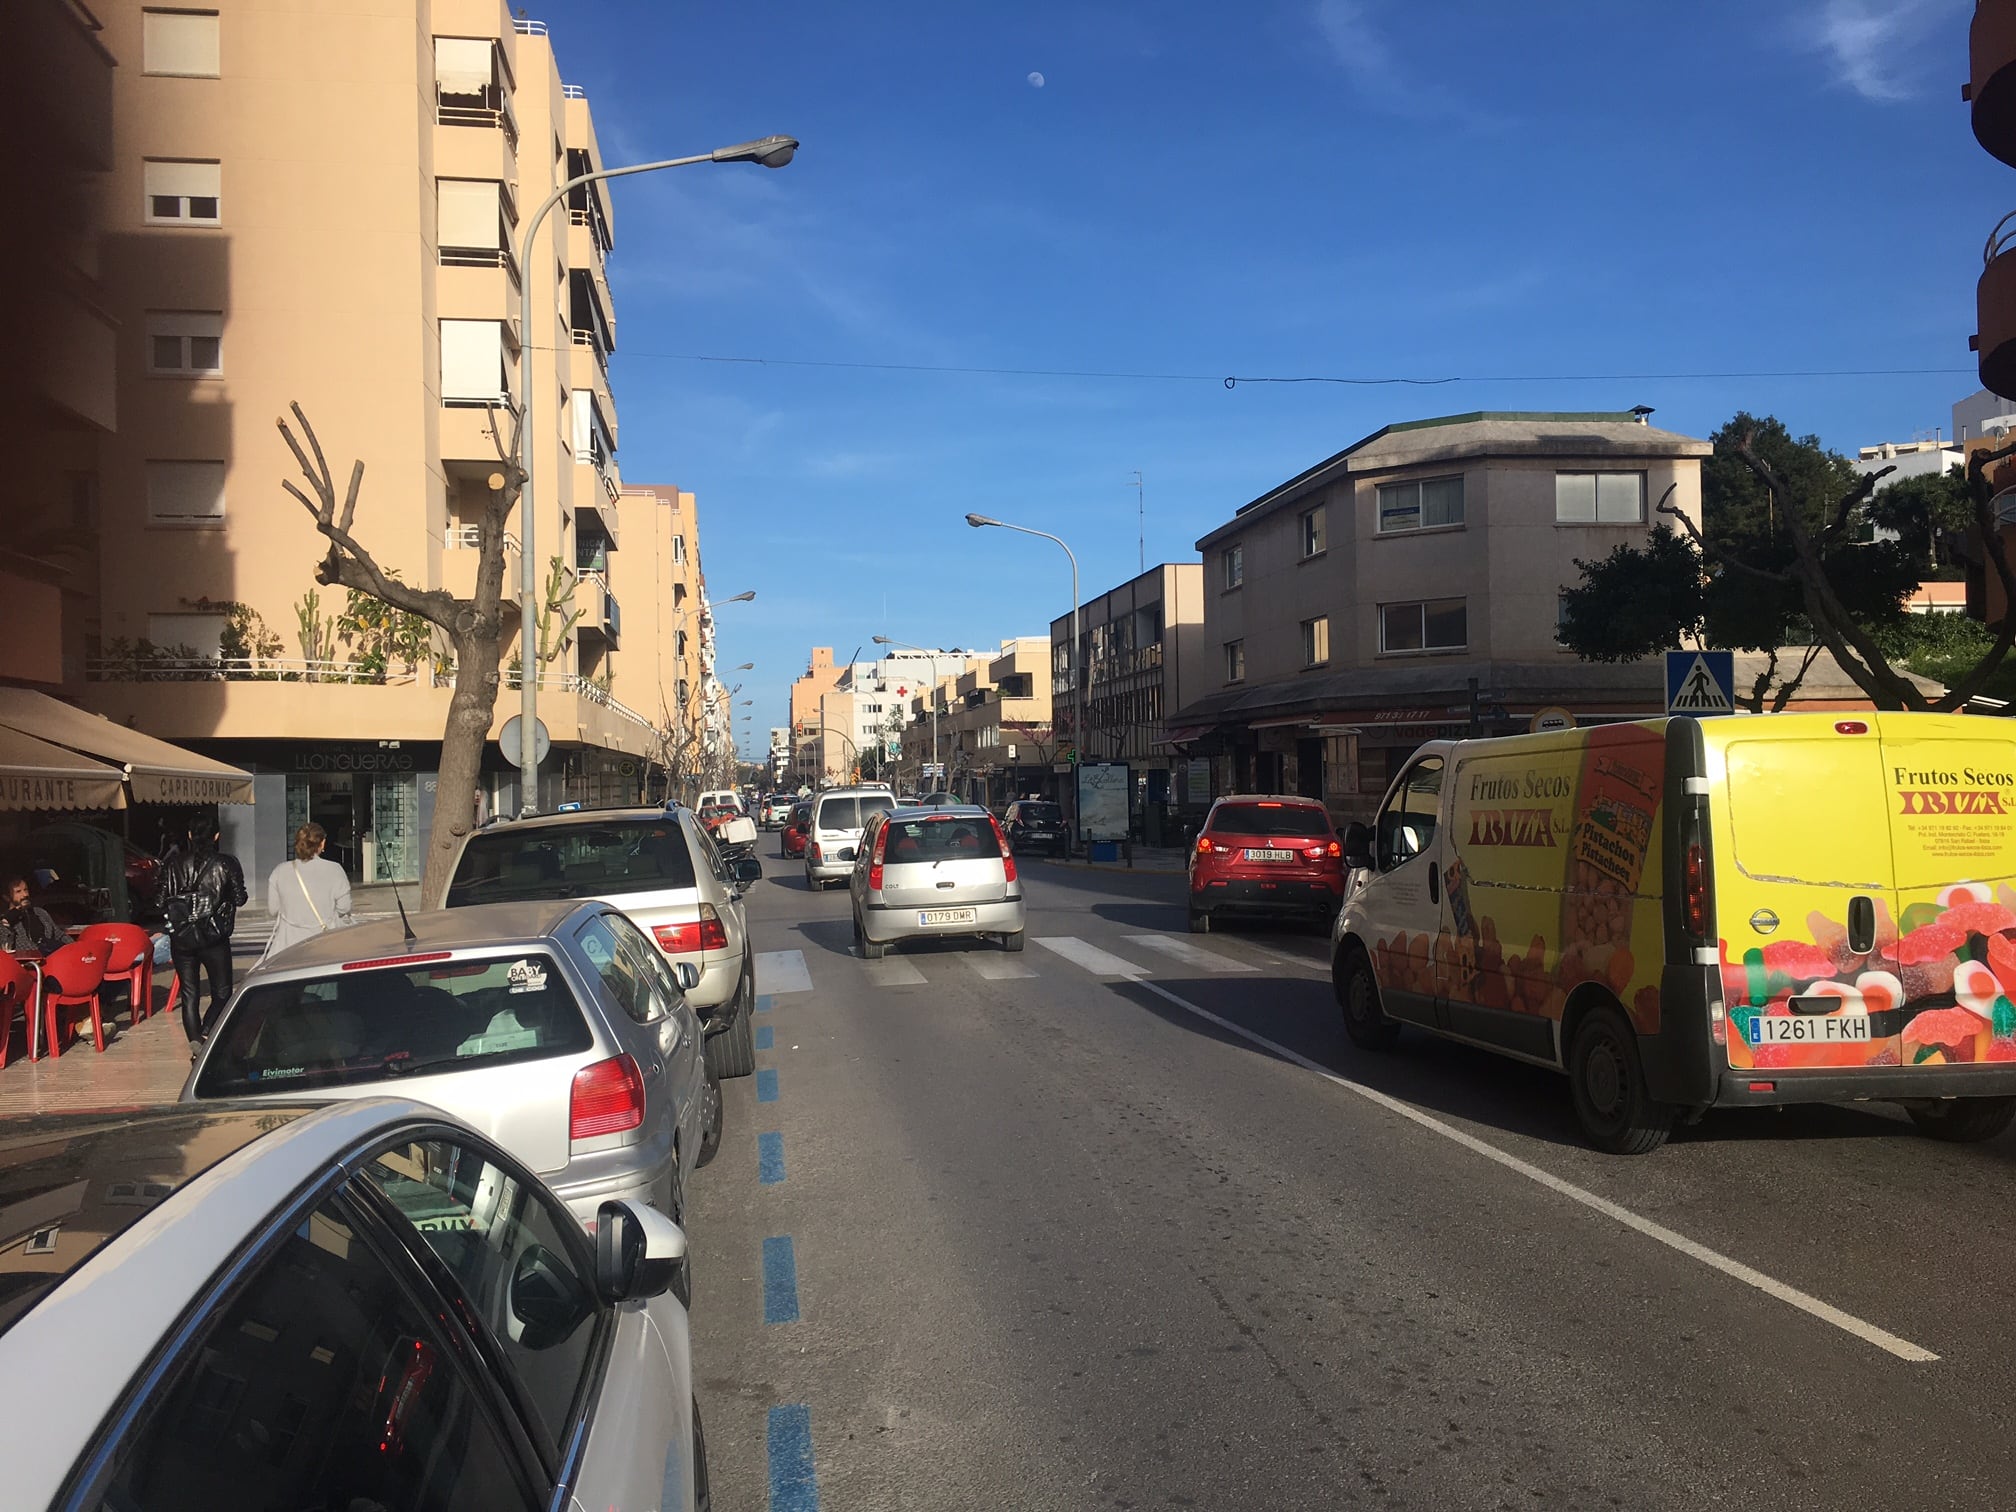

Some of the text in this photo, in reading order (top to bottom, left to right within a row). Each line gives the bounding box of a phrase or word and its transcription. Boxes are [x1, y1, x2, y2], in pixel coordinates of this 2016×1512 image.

[1470, 769, 1570, 801] Frutos Secos
[1894, 767, 2014, 786] Frutos Secos
[160, 778, 232, 799] CAPRICORNIO
[1897, 791, 2008, 815] IBIZA
[1467, 808, 1557, 847] IBIZA
[1250, 849, 1292, 859] 3019 HLB
[926, 910, 971, 922] 0179 DMR
[510, 964, 541, 978] BABY
[1766, 1019, 1815, 1040] 1261
[1826, 1018, 1866, 1039] FKH
[262, 1067, 305, 1077] Eivimotor
